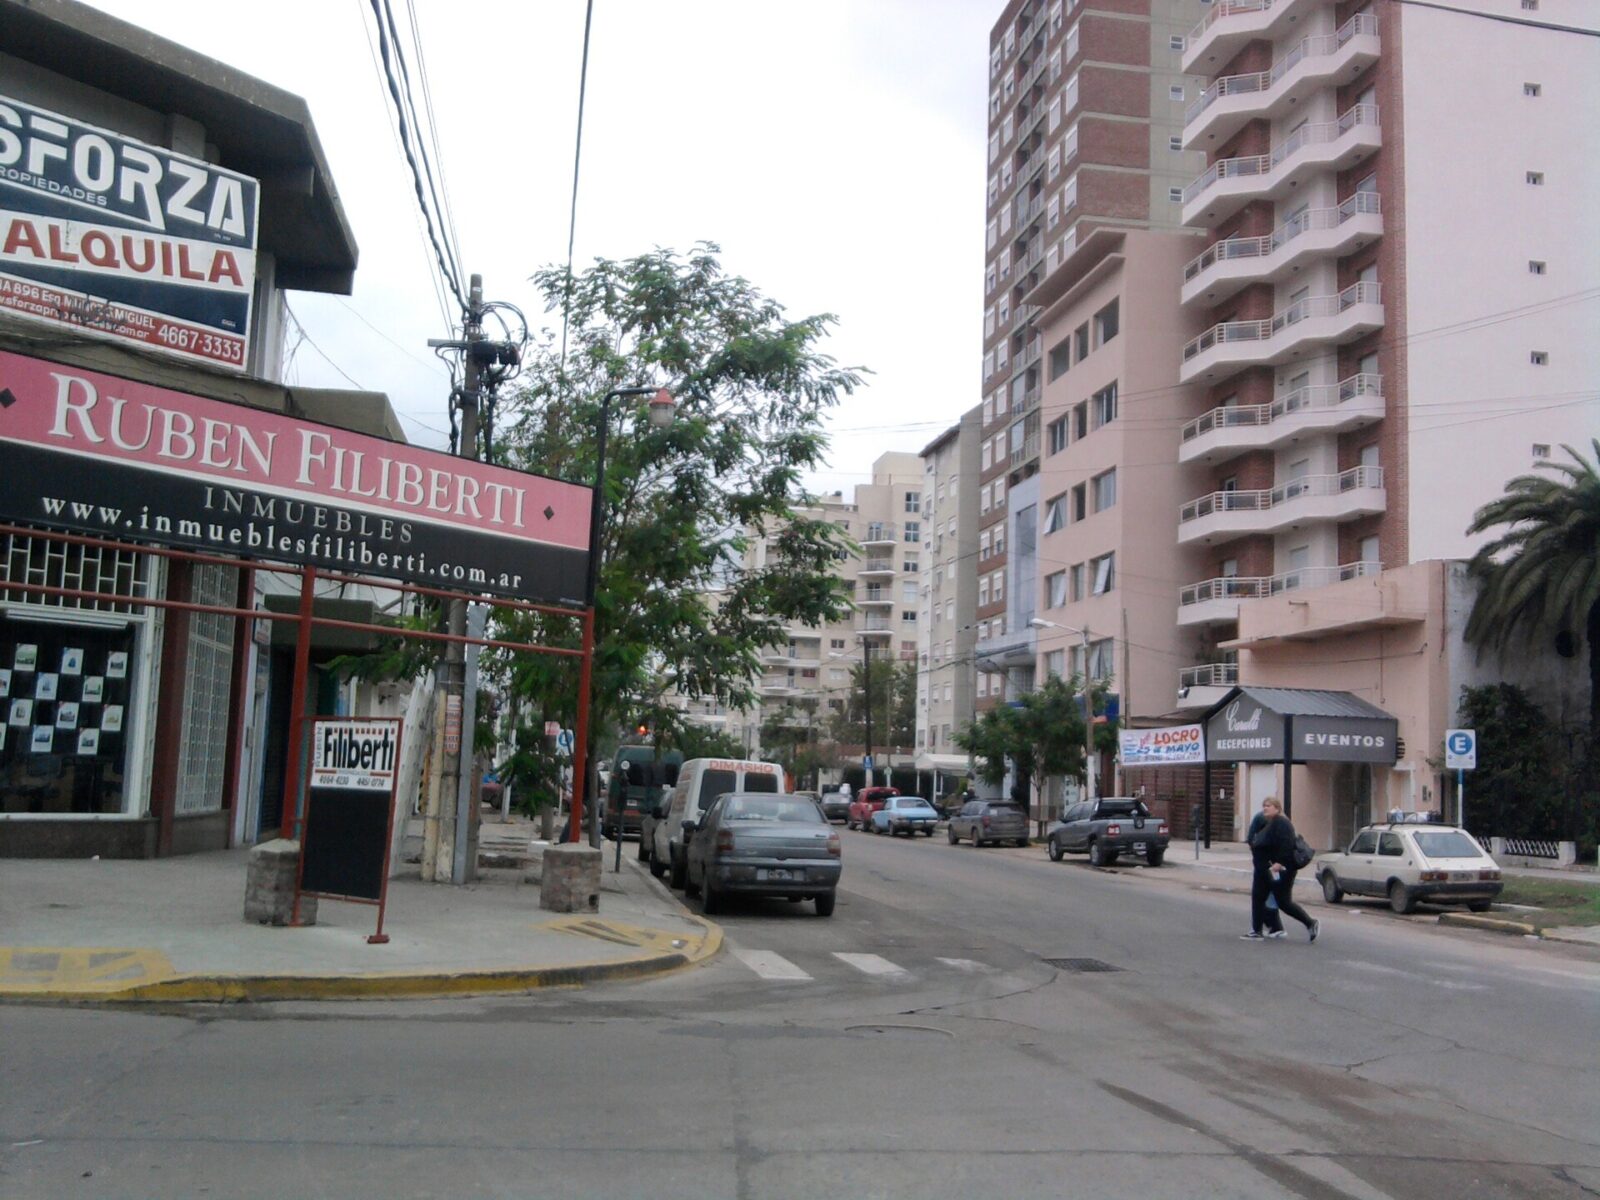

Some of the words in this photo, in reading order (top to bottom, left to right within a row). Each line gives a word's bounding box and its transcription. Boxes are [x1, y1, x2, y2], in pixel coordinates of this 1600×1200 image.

[4, 219, 244, 287] ALQUILA
[13, 283, 39, 299] 896
[42, 290, 61, 307] Esq
[158, 325, 241, 360] 4667-3333
[48, 372, 277, 477] RUBEN
[296, 428, 526, 528] FILIBERTI
[204, 487, 413, 543] INMUEBLES
[42, 497, 522, 589] www.inmueblesfiliberti.com.ar
[323, 727, 395, 771] Filiberti
[1154, 728, 1199, 745] LOCRO
[1165, 742, 1200, 754] MAYO
[1217, 737, 1272, 750] RECEPCIONES
[1304, 733, 1385, 748] EVENTOS
[1455, 736, 1466, 751] E
